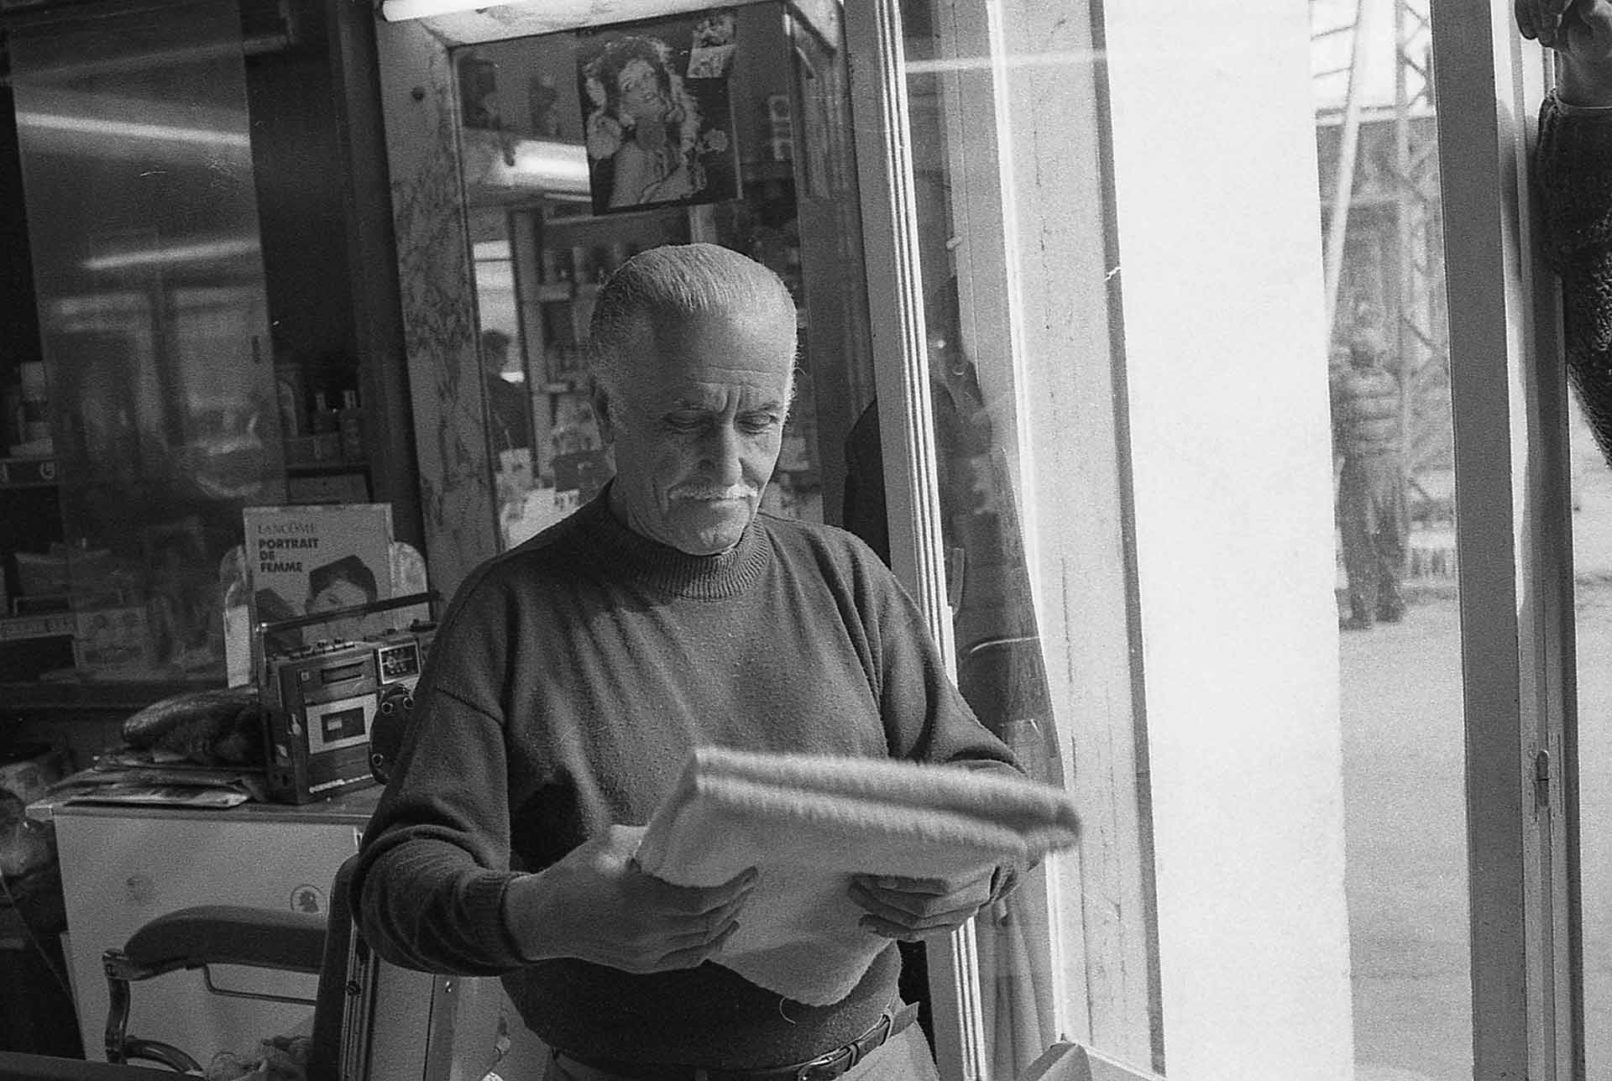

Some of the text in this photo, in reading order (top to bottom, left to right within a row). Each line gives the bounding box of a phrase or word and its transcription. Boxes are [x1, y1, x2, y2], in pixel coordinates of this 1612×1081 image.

[258, 538, 319, 549] PORTRAIT
[260, 550, 275, 561] DE
[261, 562, 304, 573] FEMME
